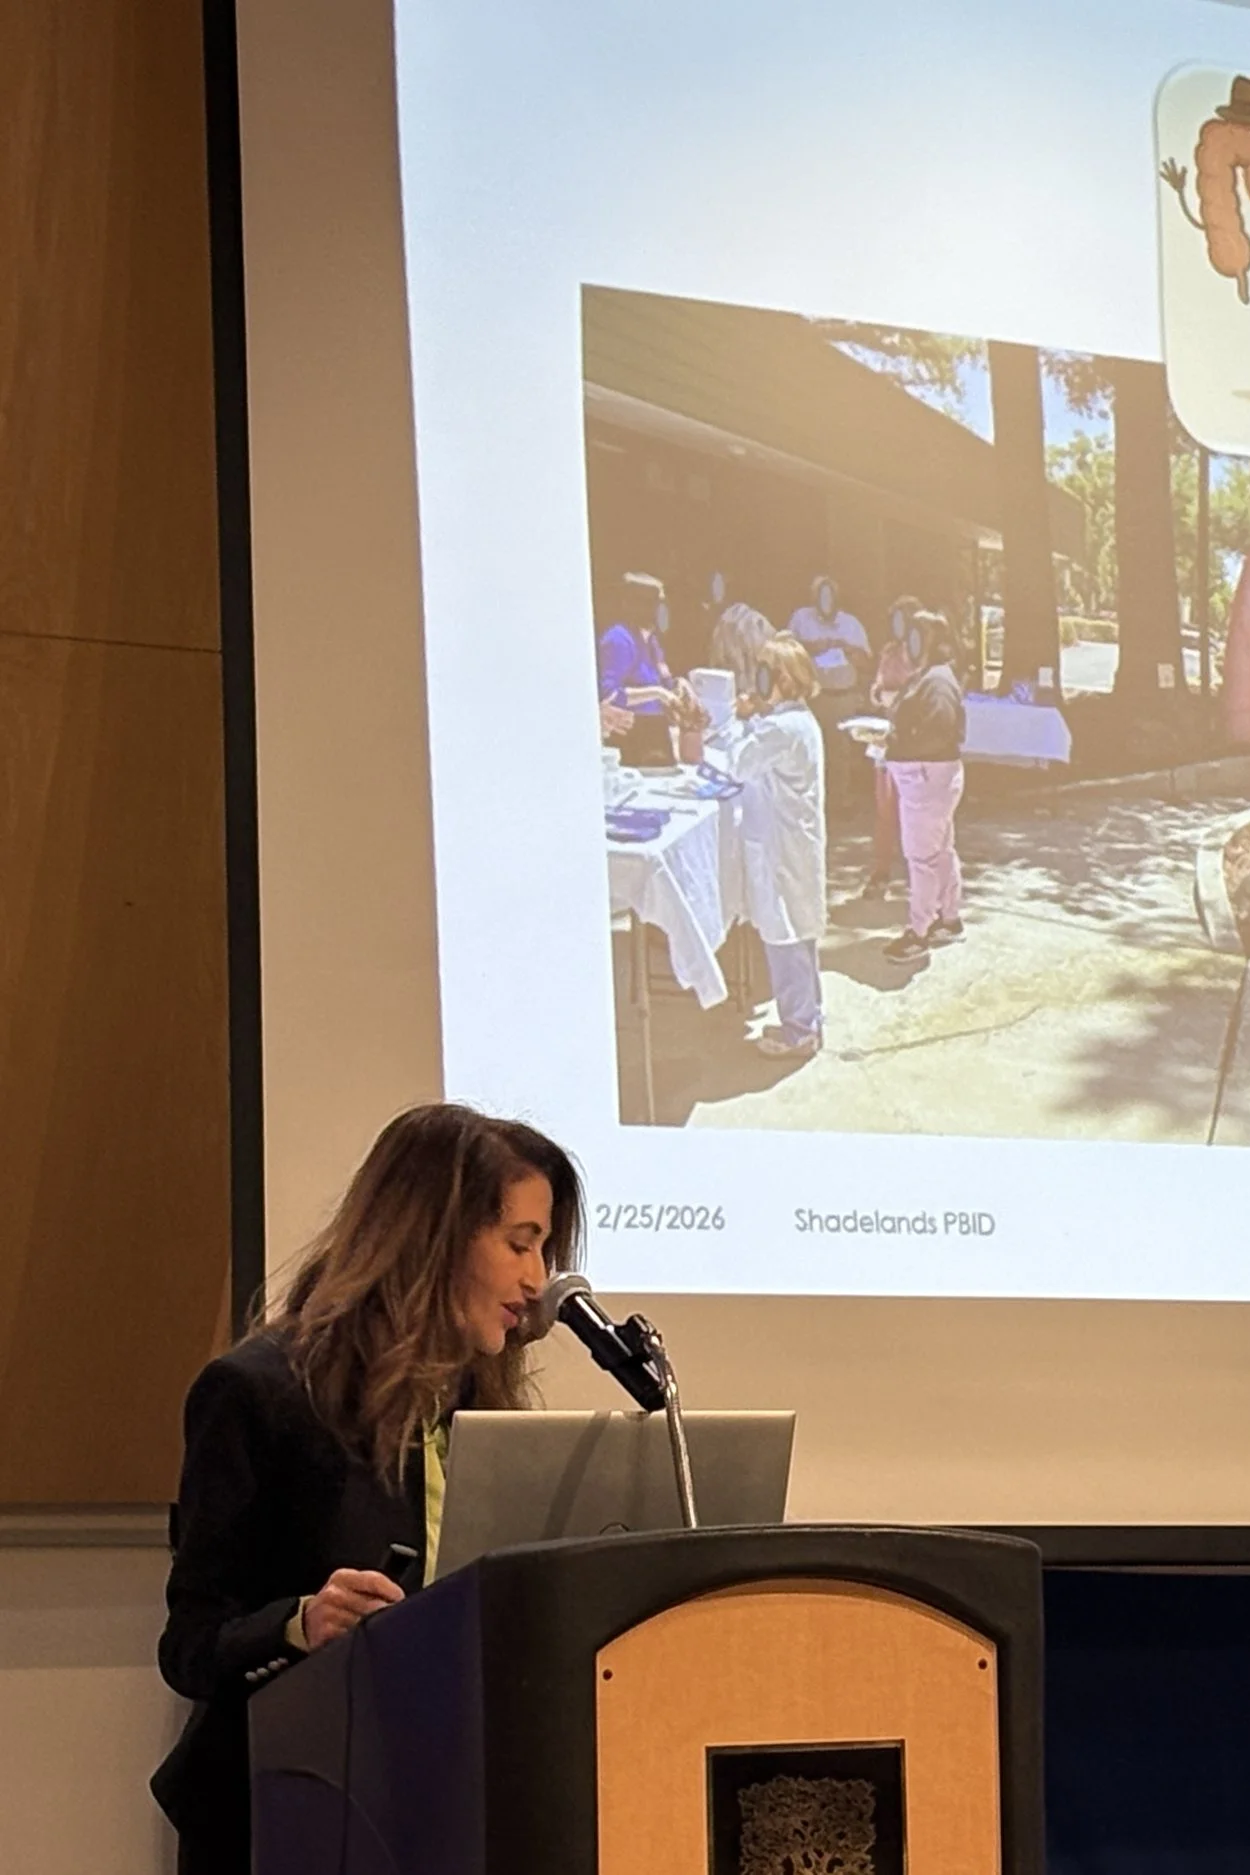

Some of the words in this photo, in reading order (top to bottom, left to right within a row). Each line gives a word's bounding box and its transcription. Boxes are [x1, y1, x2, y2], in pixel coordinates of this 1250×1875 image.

[596, 1204, 726, 1232] 2/25/2026
[794, 1208, 938, 1235] Shadelands
[943, 1211, 995, 1236] PBID
